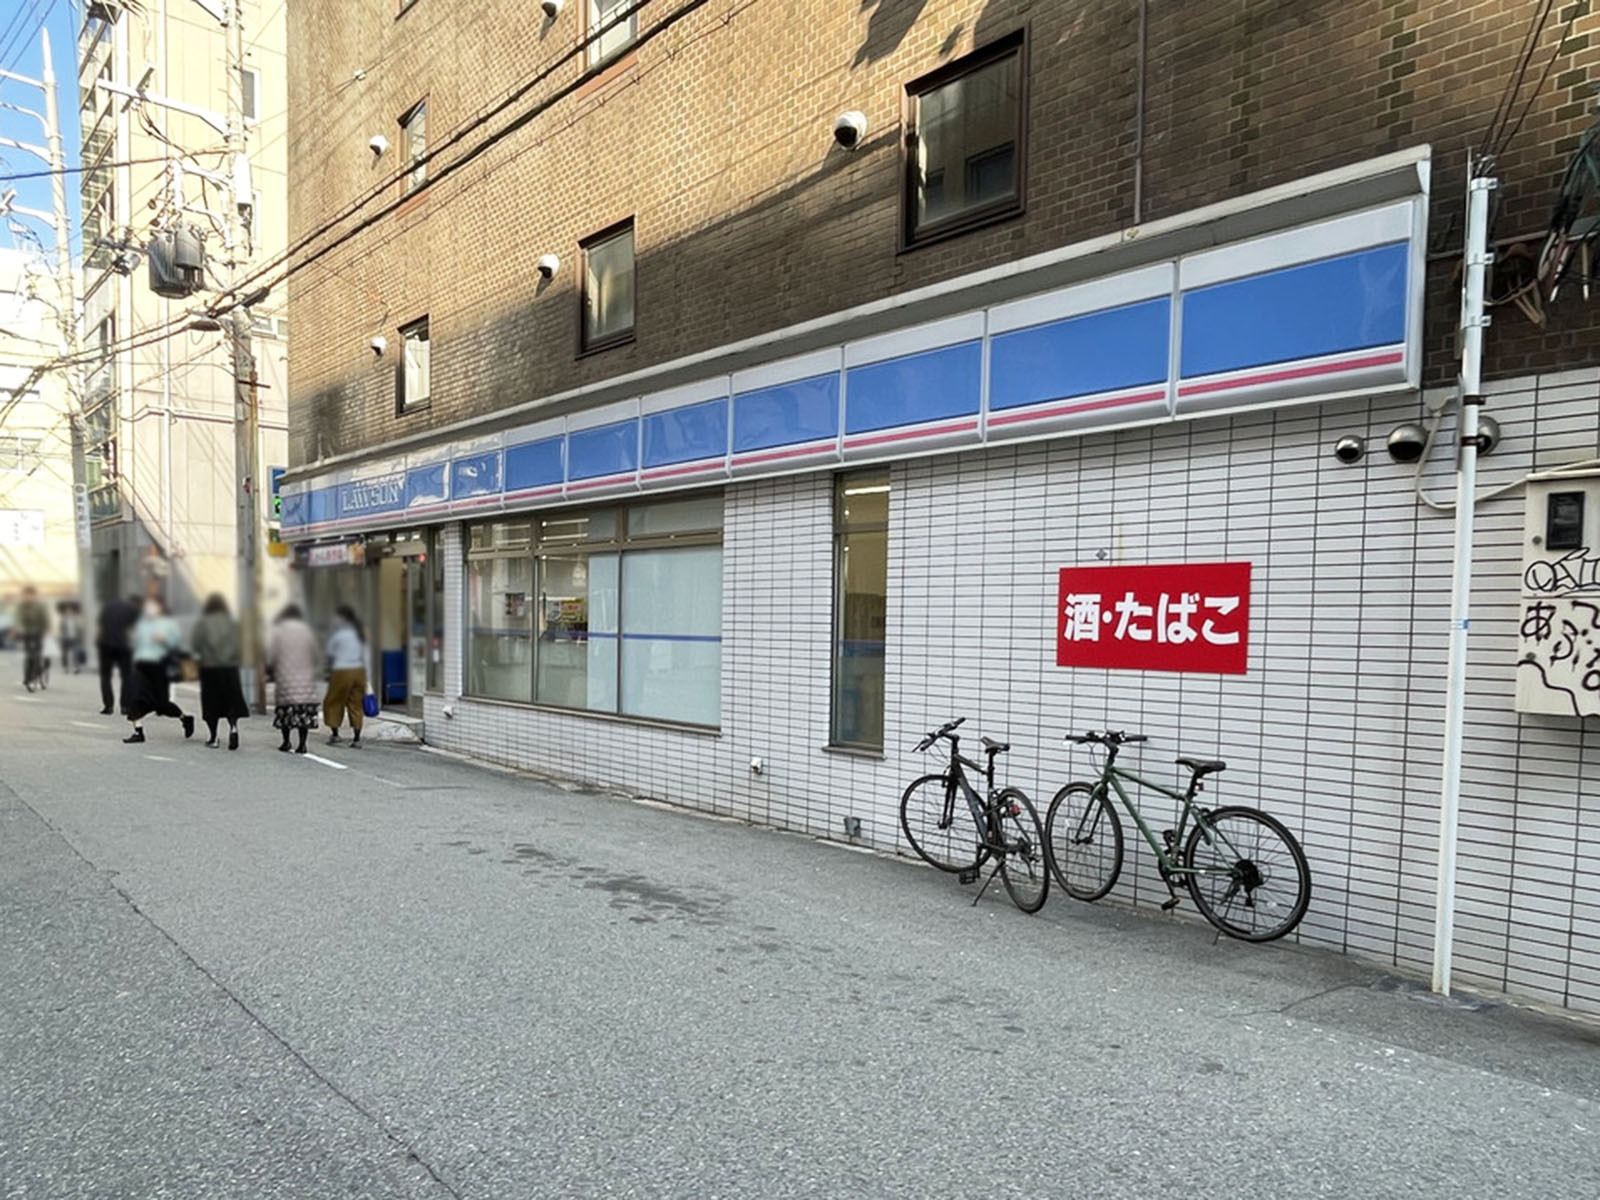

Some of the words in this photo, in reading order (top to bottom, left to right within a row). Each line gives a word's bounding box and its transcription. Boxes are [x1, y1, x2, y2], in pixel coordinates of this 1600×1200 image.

[342, 482, 399, 512] LAWSON
[1064, 592, 1240, 645] 酒・たばこ
